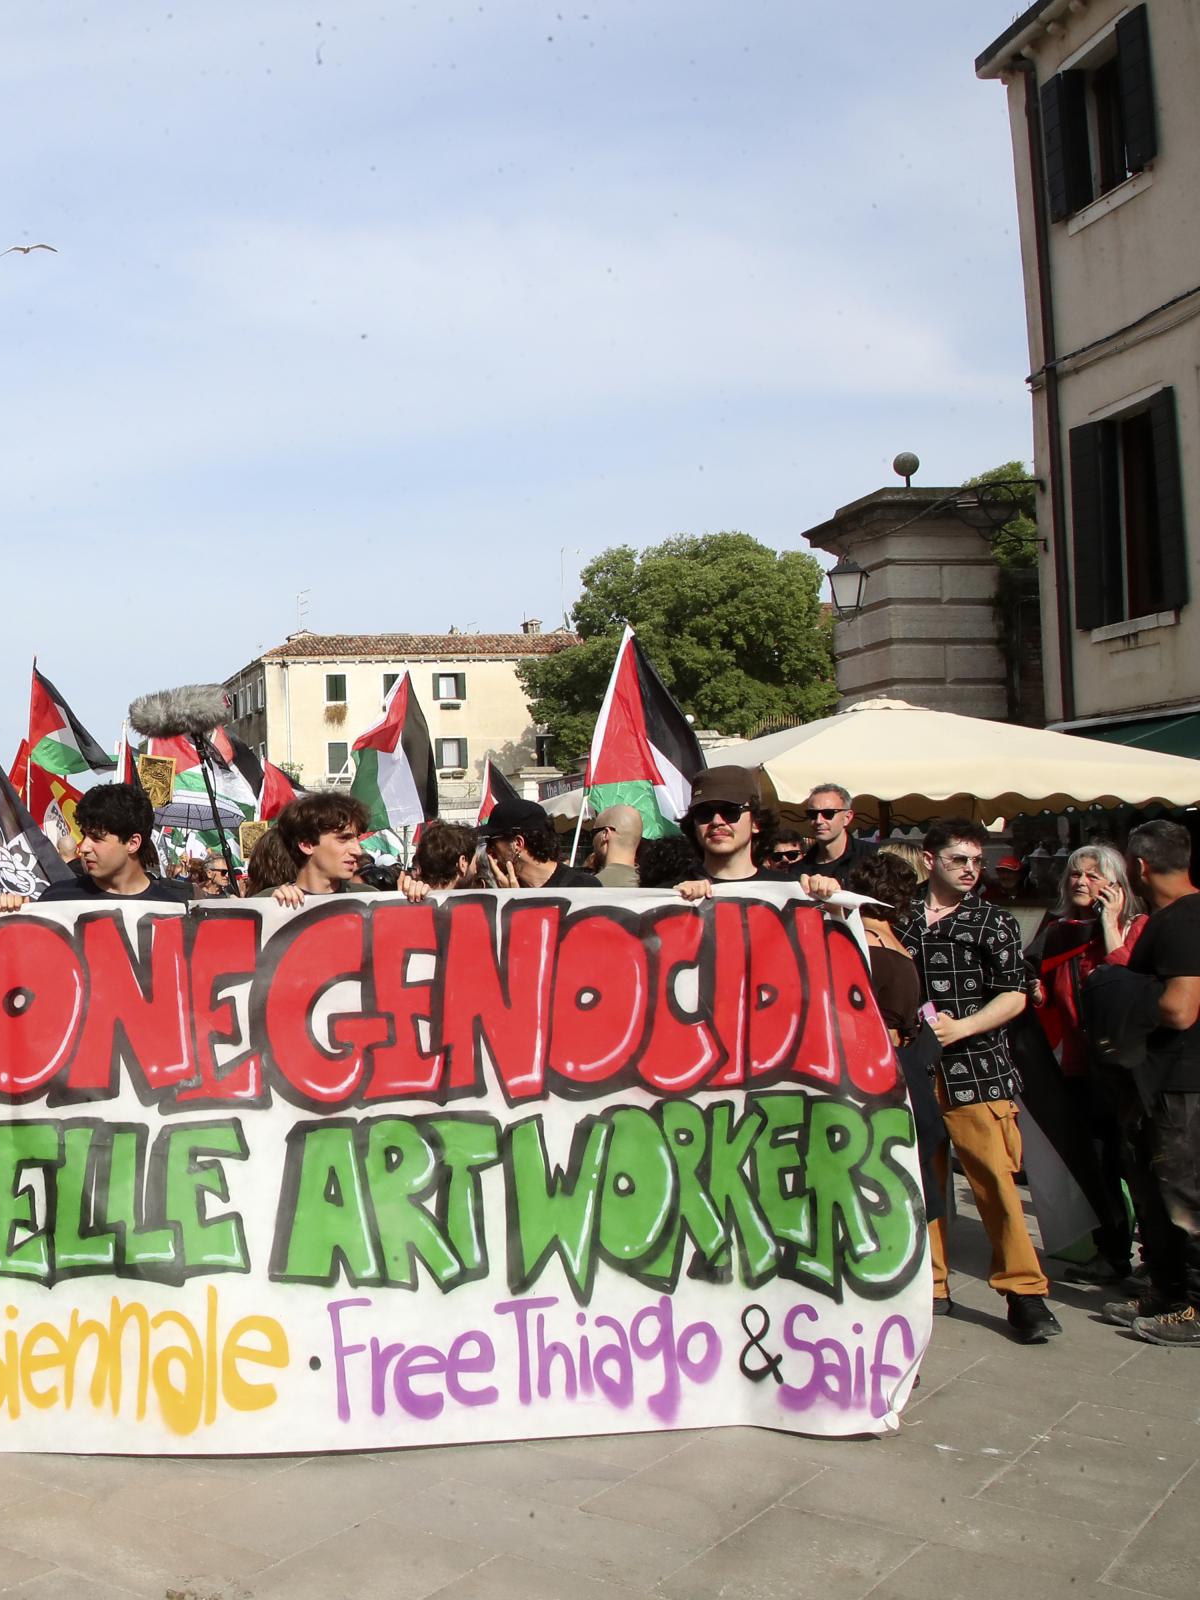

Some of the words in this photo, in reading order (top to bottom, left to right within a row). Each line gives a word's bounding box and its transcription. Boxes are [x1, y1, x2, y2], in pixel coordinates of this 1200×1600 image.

[249, 895, 905, 1110] GENOCIDIO
[268, 1110, 500, 1295] ART
[503, 1090, 926, 1308] WORKERS
[326, 1297, 499, 1423] Free
[493, 1295, 723, 1425] Thiago
[738, 1303, 785, 1385] &
[775, 1303, 916, 1420] Saif
